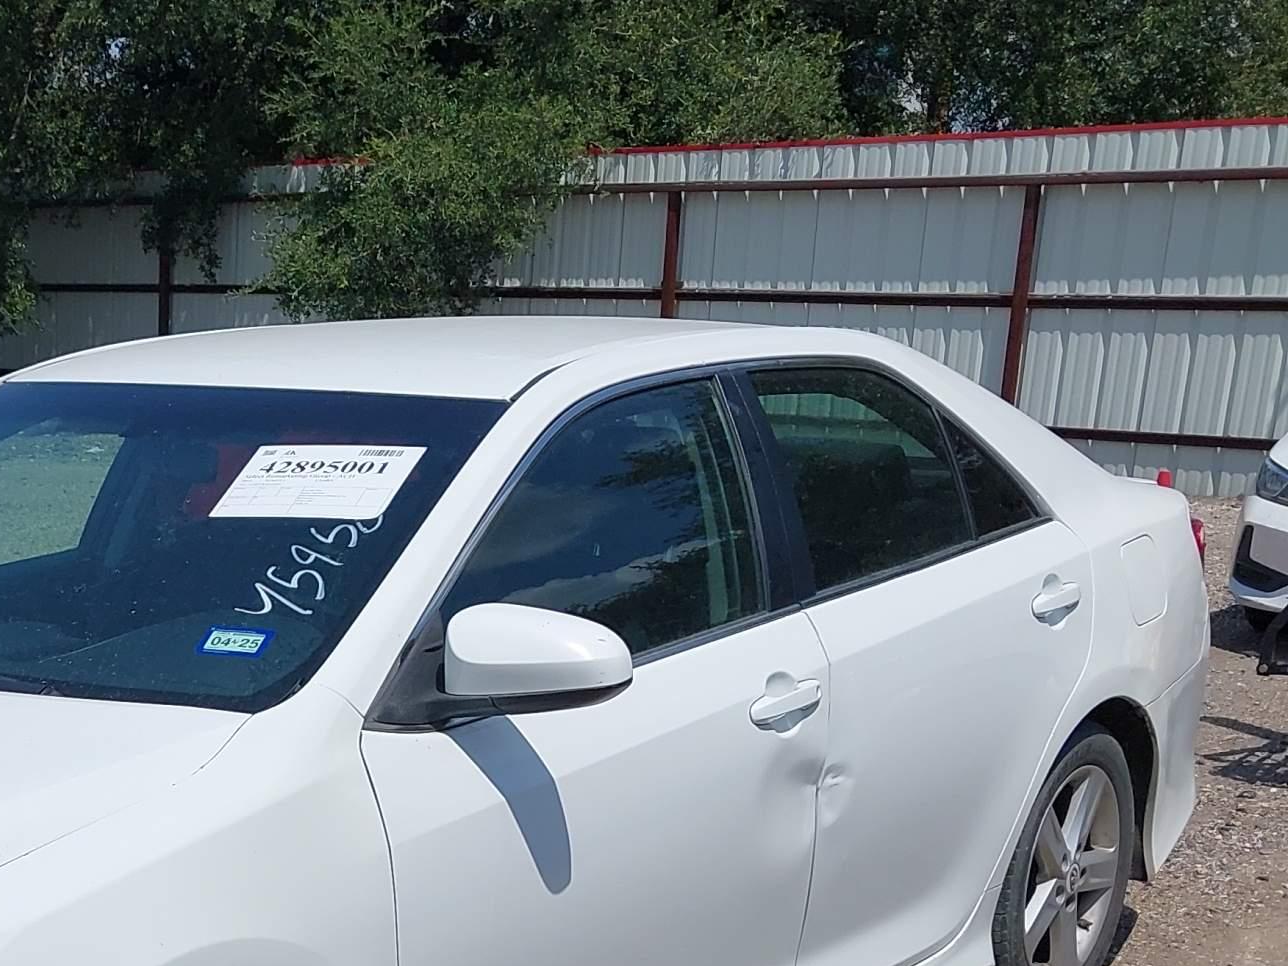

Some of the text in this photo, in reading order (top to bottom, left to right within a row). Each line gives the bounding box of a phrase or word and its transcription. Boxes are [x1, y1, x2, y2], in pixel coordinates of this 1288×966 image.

[259, 460, 390, 475] 42895001
[210, 636, 261, 649] 04 25
